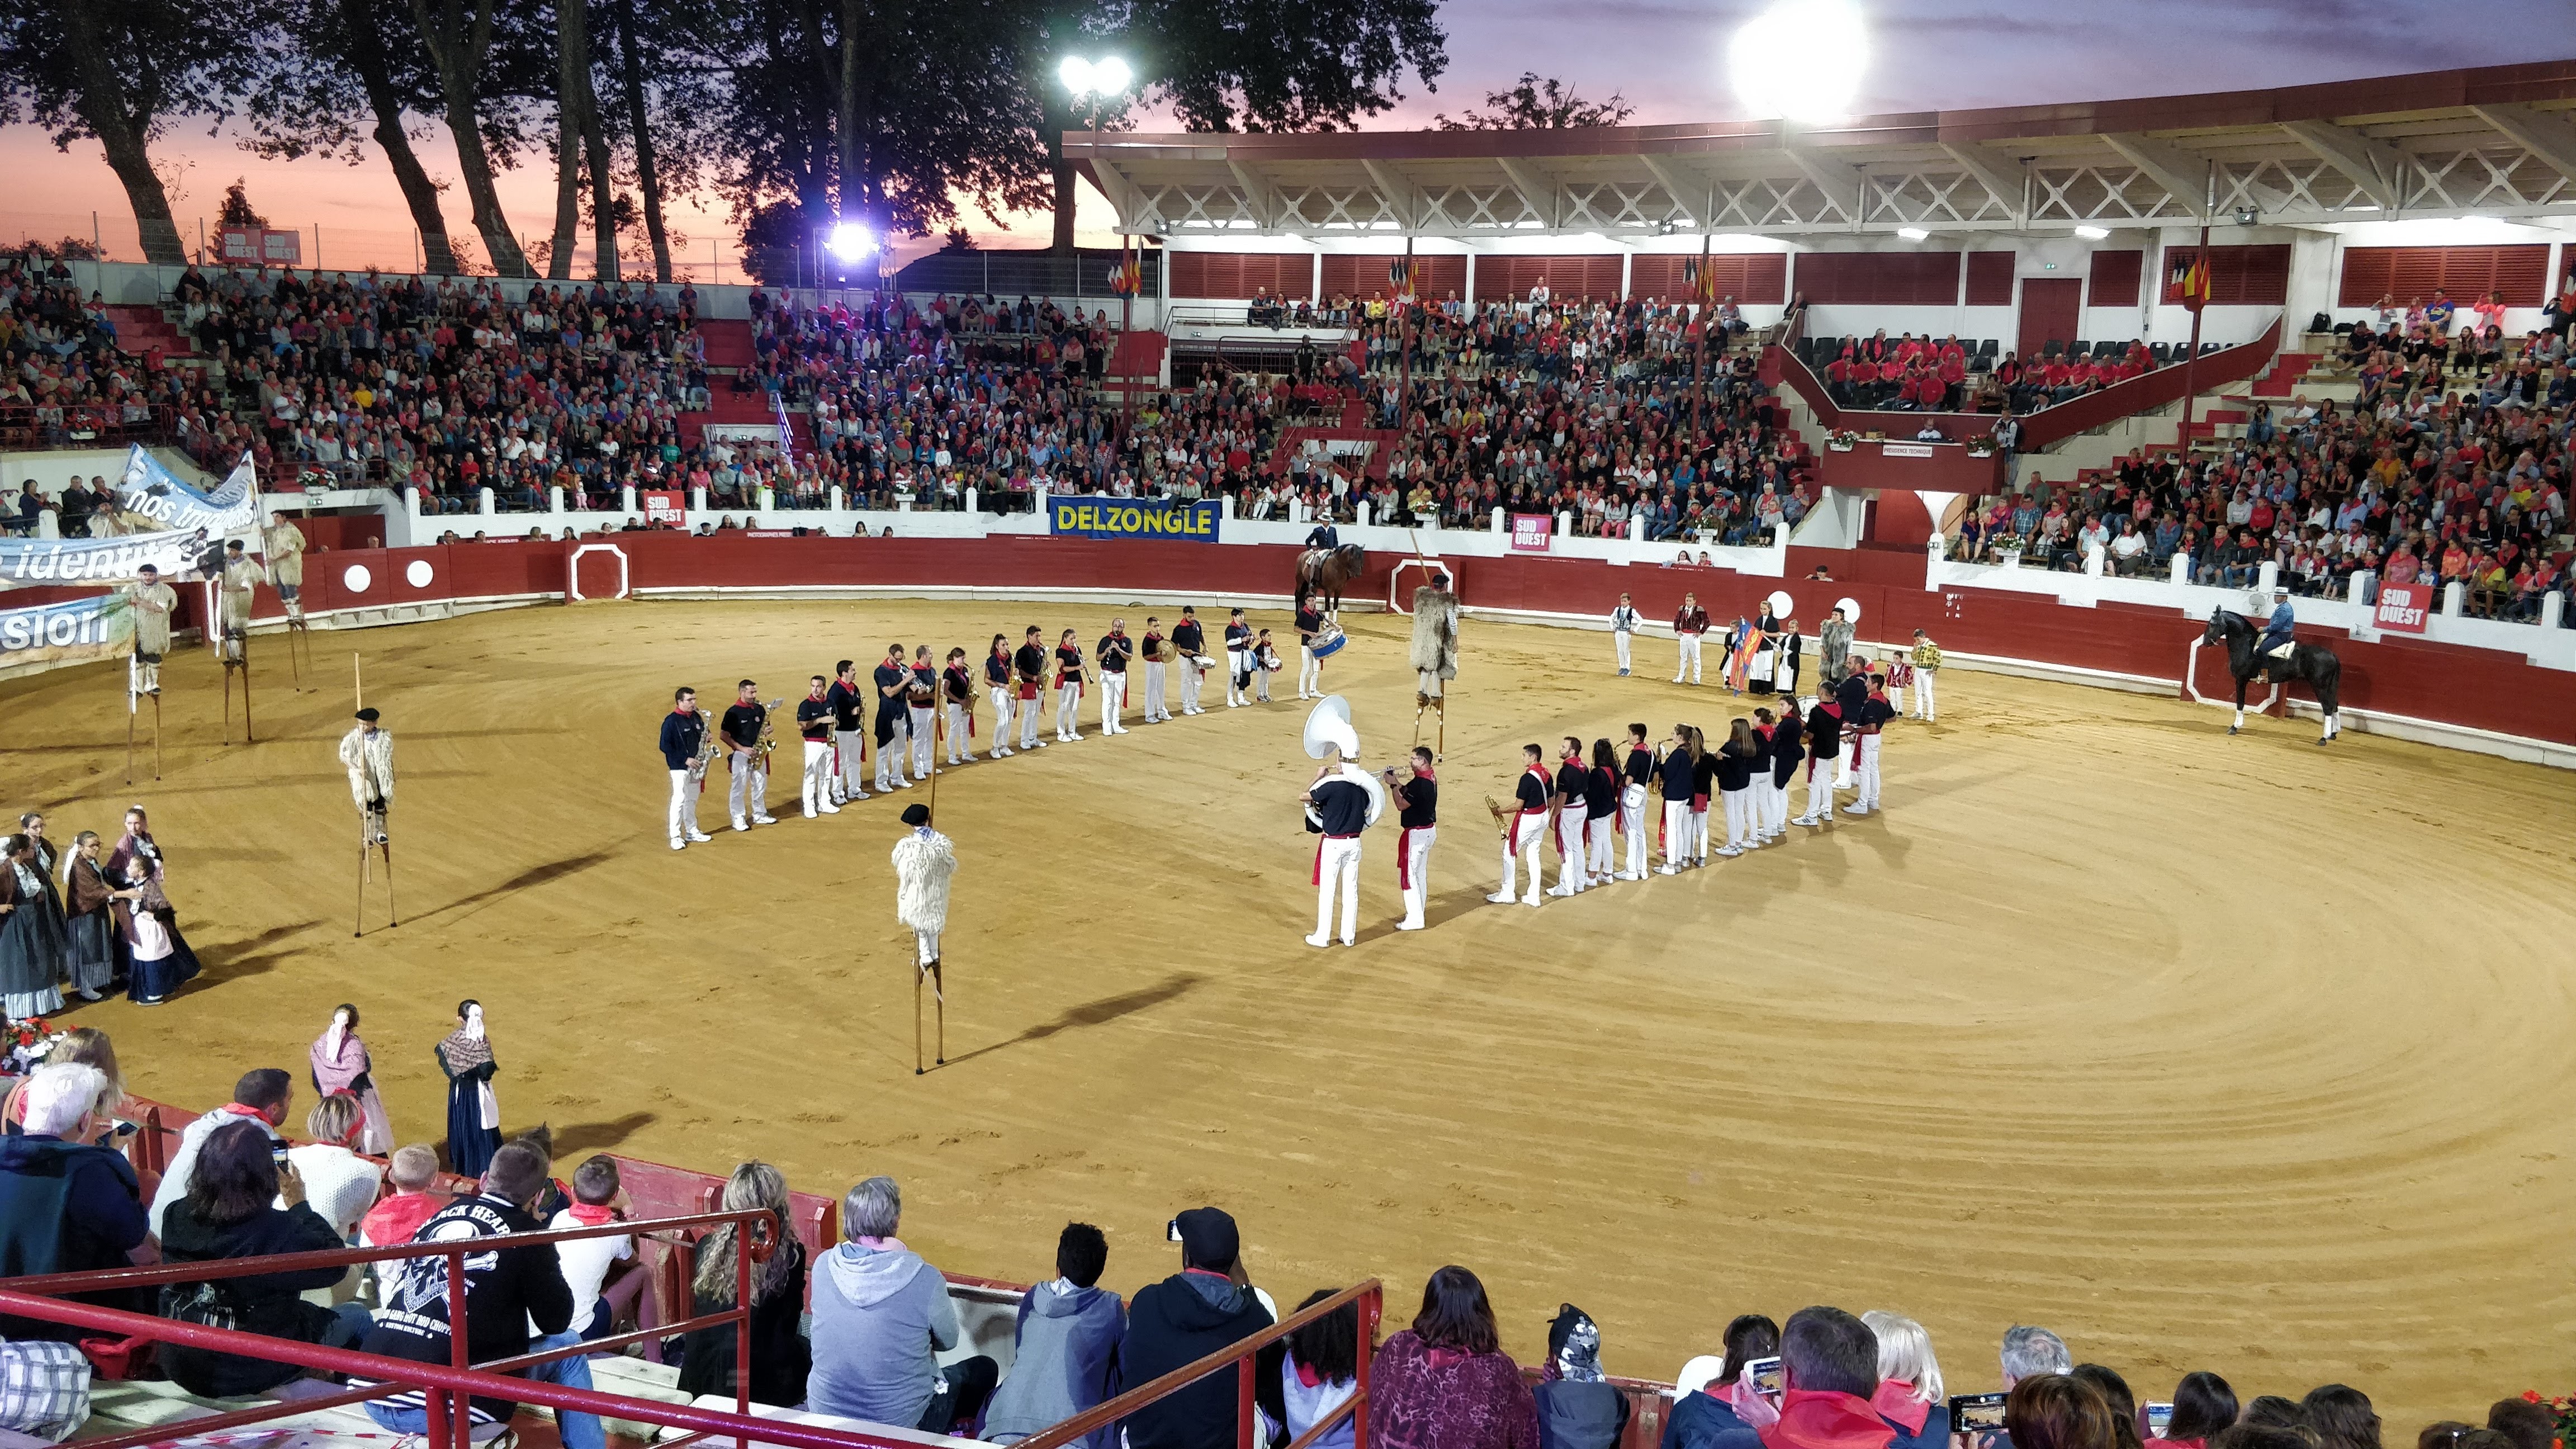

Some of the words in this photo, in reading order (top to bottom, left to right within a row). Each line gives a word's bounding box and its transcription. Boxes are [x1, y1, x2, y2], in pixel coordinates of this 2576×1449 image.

[224, 233, 246, 245] SUD
[264, 234, 285, 247] SUD
[225, 245, 258, 258] OUEST
[265, 247, 297, 260] OUEST
[125, 488, 177, 522] nos
[647, 496, 670, 509] SUD
[648, 509, 682, 522] OUEST
[1057, 505, 1212, 534] DELZONGLE
[1516, 519, 1537, 533] SUD
[1514, 532, 1547, 546] OUEST
[2381, 588, 2411, 607] SUD
[2378, 605, 2424, 626] OUEST
[470, 1205, 511, 1235] HEAR
